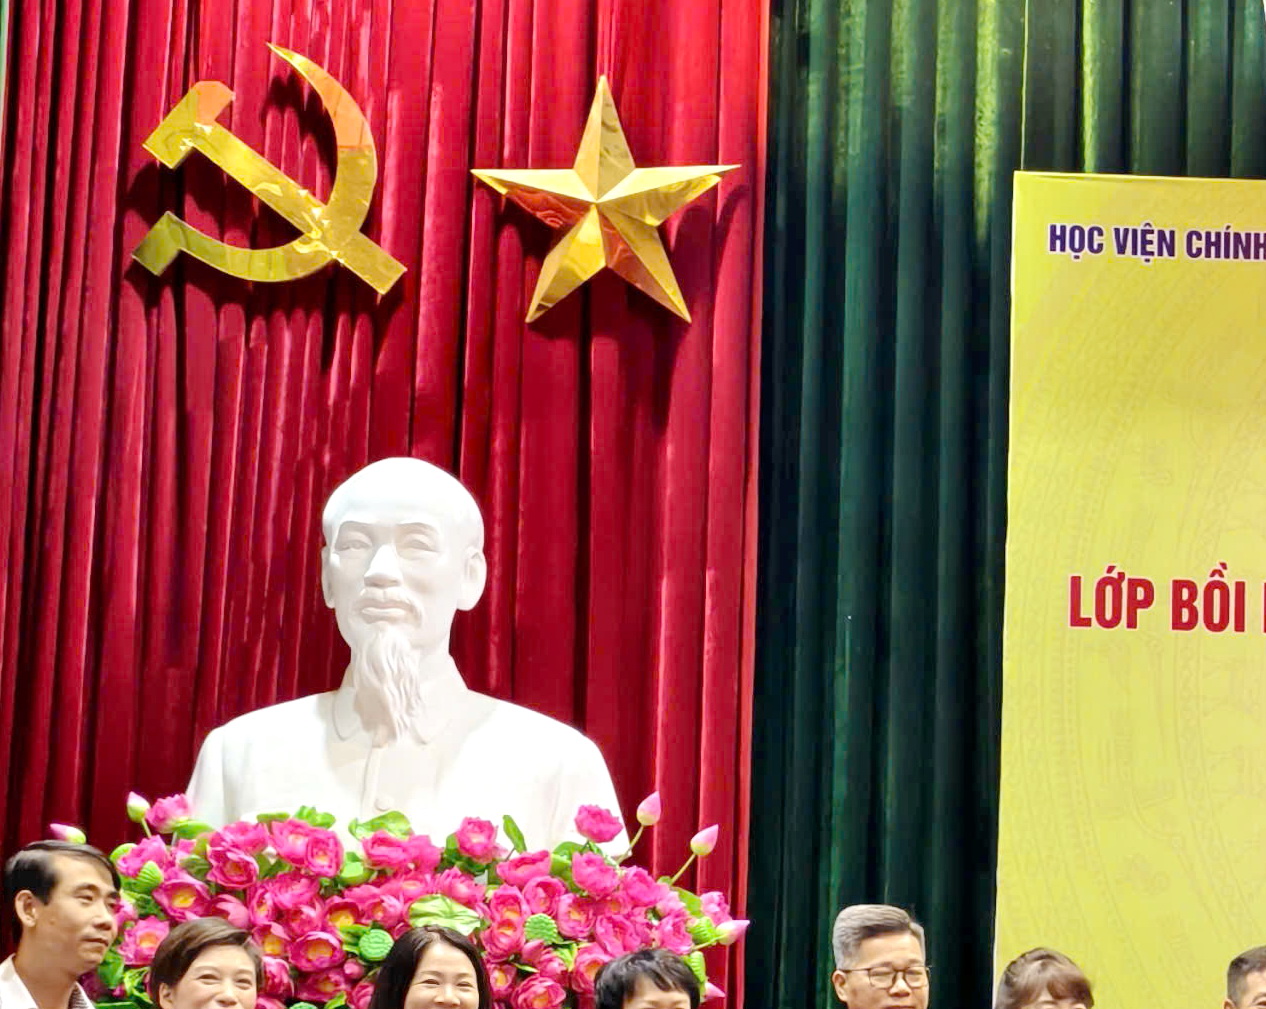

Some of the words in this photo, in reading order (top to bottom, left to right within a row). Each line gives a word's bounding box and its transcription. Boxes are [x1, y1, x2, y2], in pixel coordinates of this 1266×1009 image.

[1049, 224, 1104, 260] HỌC
[1113, 222, 1176, 263] VIỆN
[1069, 565, 1155, 630] LỚP
[1171, 562, 1246, 633] BỒI
